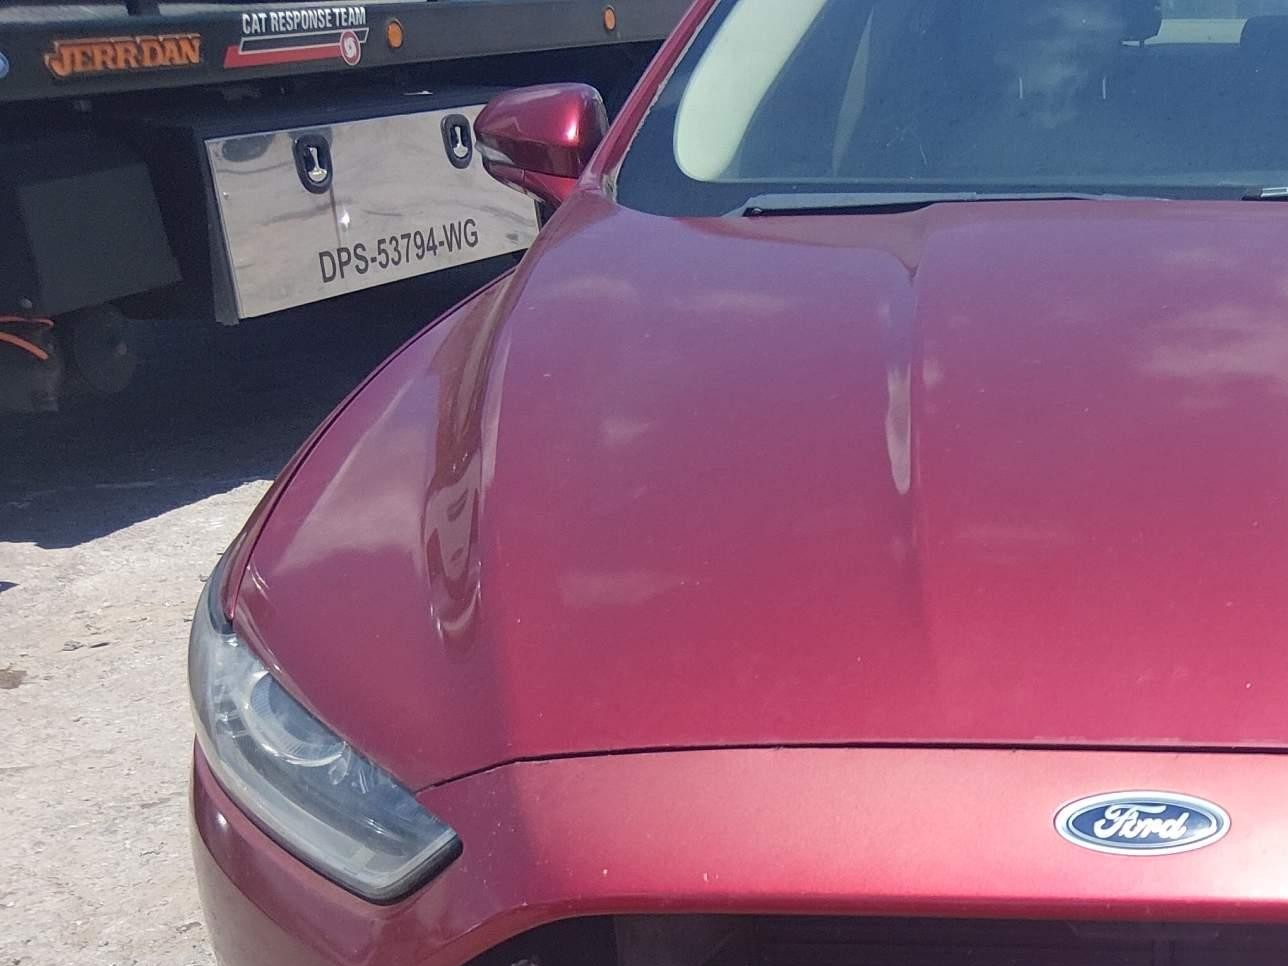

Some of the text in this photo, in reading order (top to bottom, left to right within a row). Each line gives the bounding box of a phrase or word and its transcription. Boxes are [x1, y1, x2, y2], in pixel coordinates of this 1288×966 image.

[242, 7, 367, 34] CAT RESPONSE TEAM
[319, 218, 479, 283] DPS-53794-WG
[1093, 804, 1190, 839] Ford
